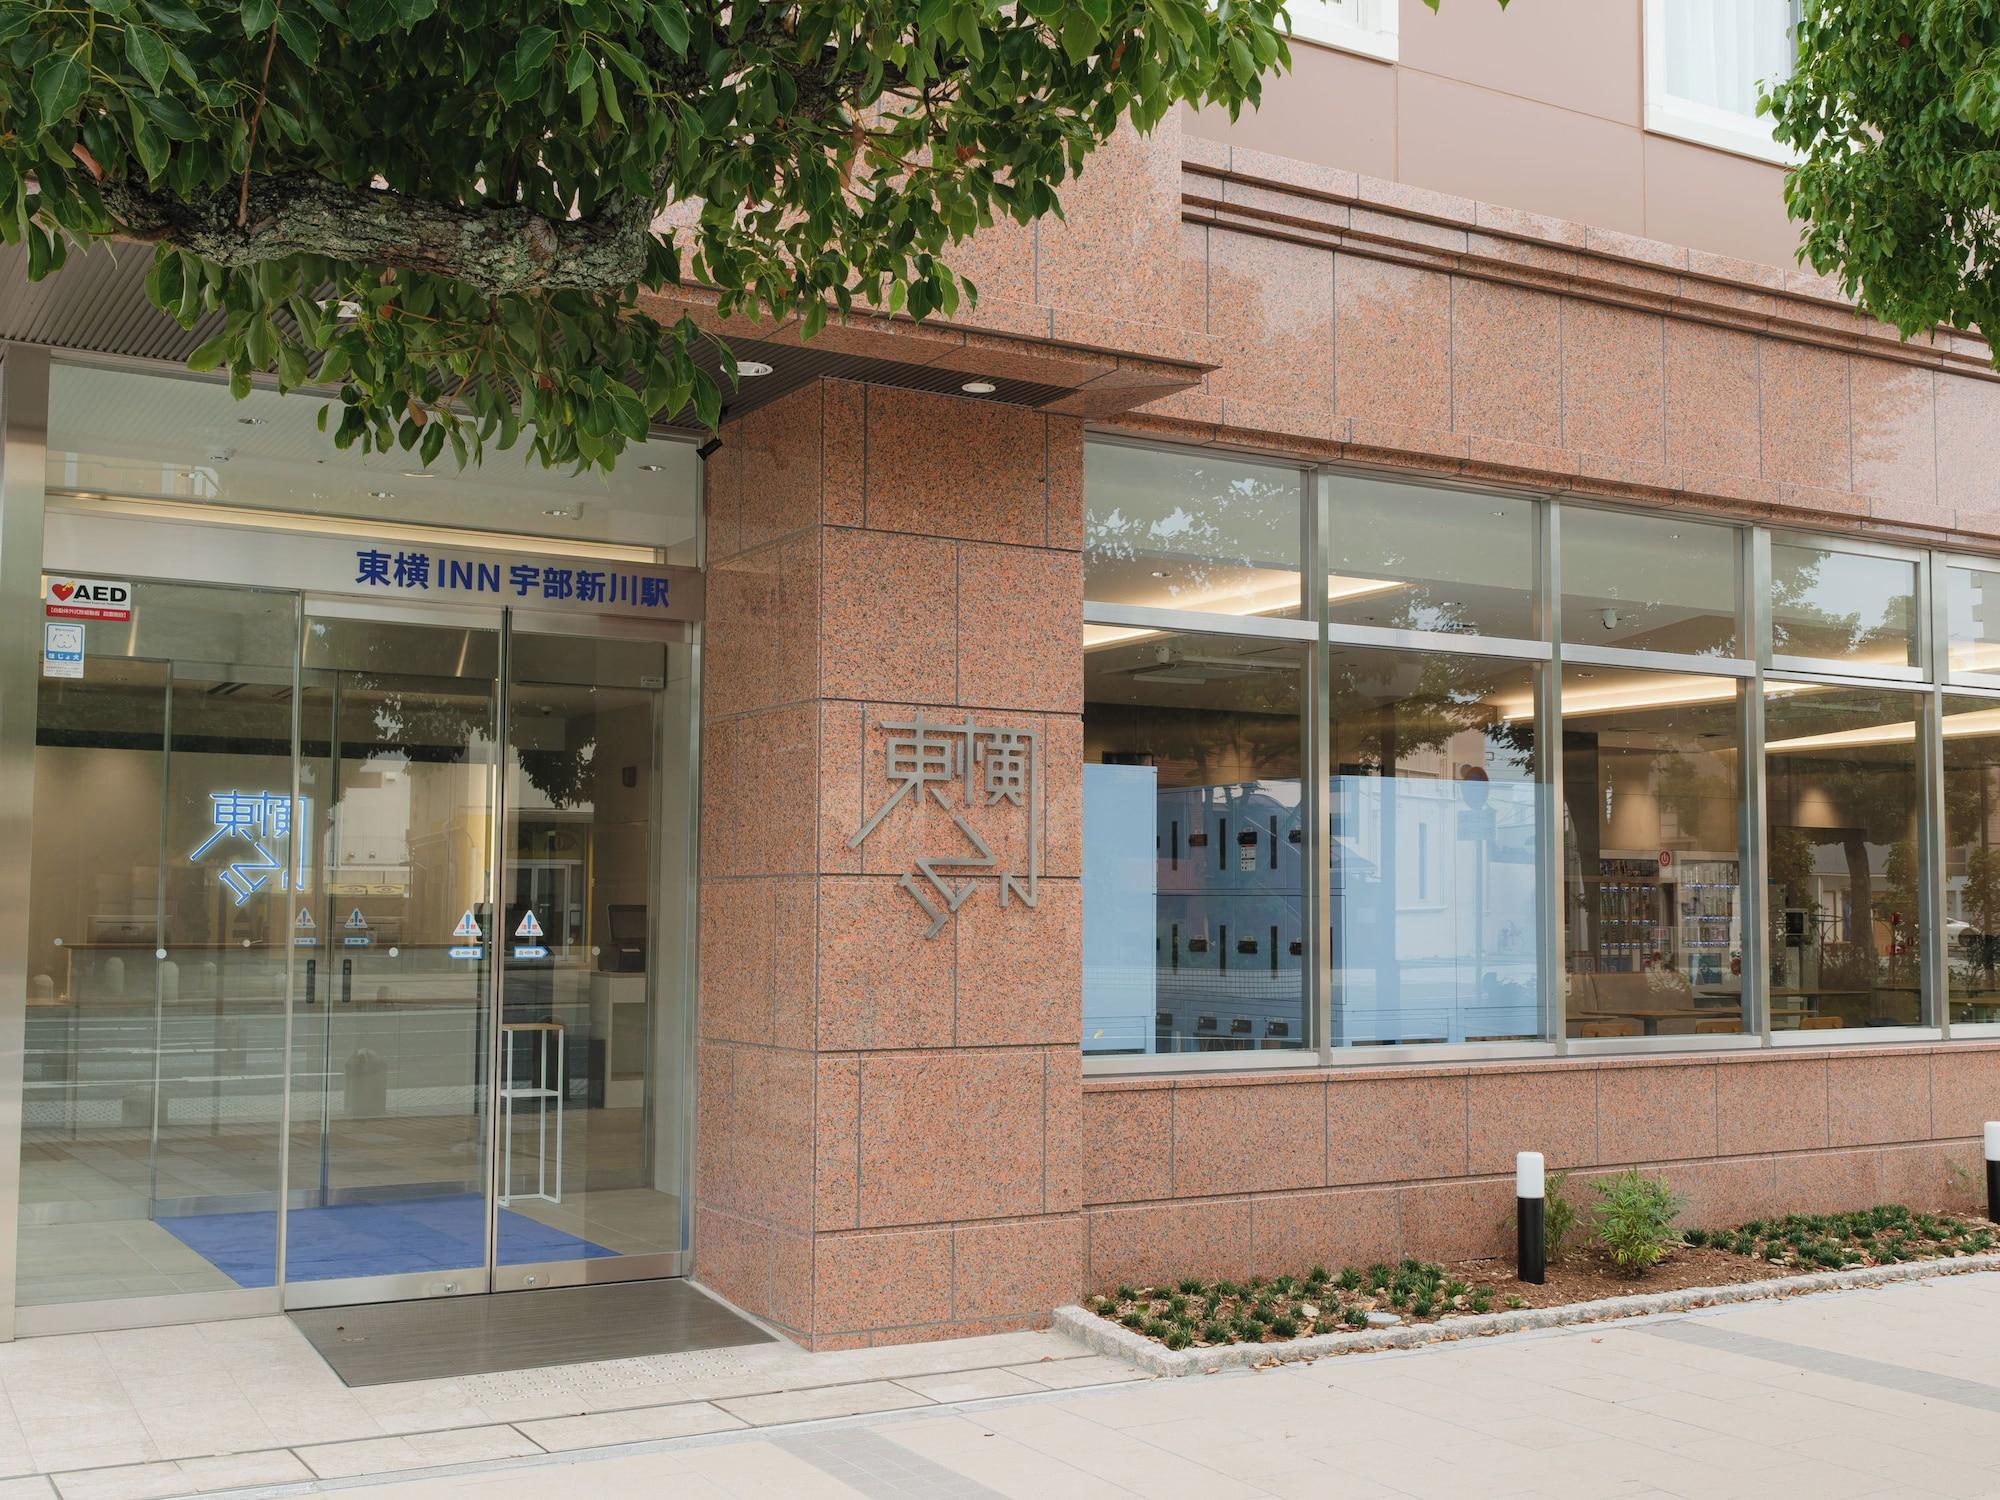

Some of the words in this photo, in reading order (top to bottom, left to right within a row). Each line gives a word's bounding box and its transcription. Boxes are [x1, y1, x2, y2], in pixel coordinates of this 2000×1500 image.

[74, 585, 127, 603] AED
[509, 565, 670, 608] 宇部新川駅
